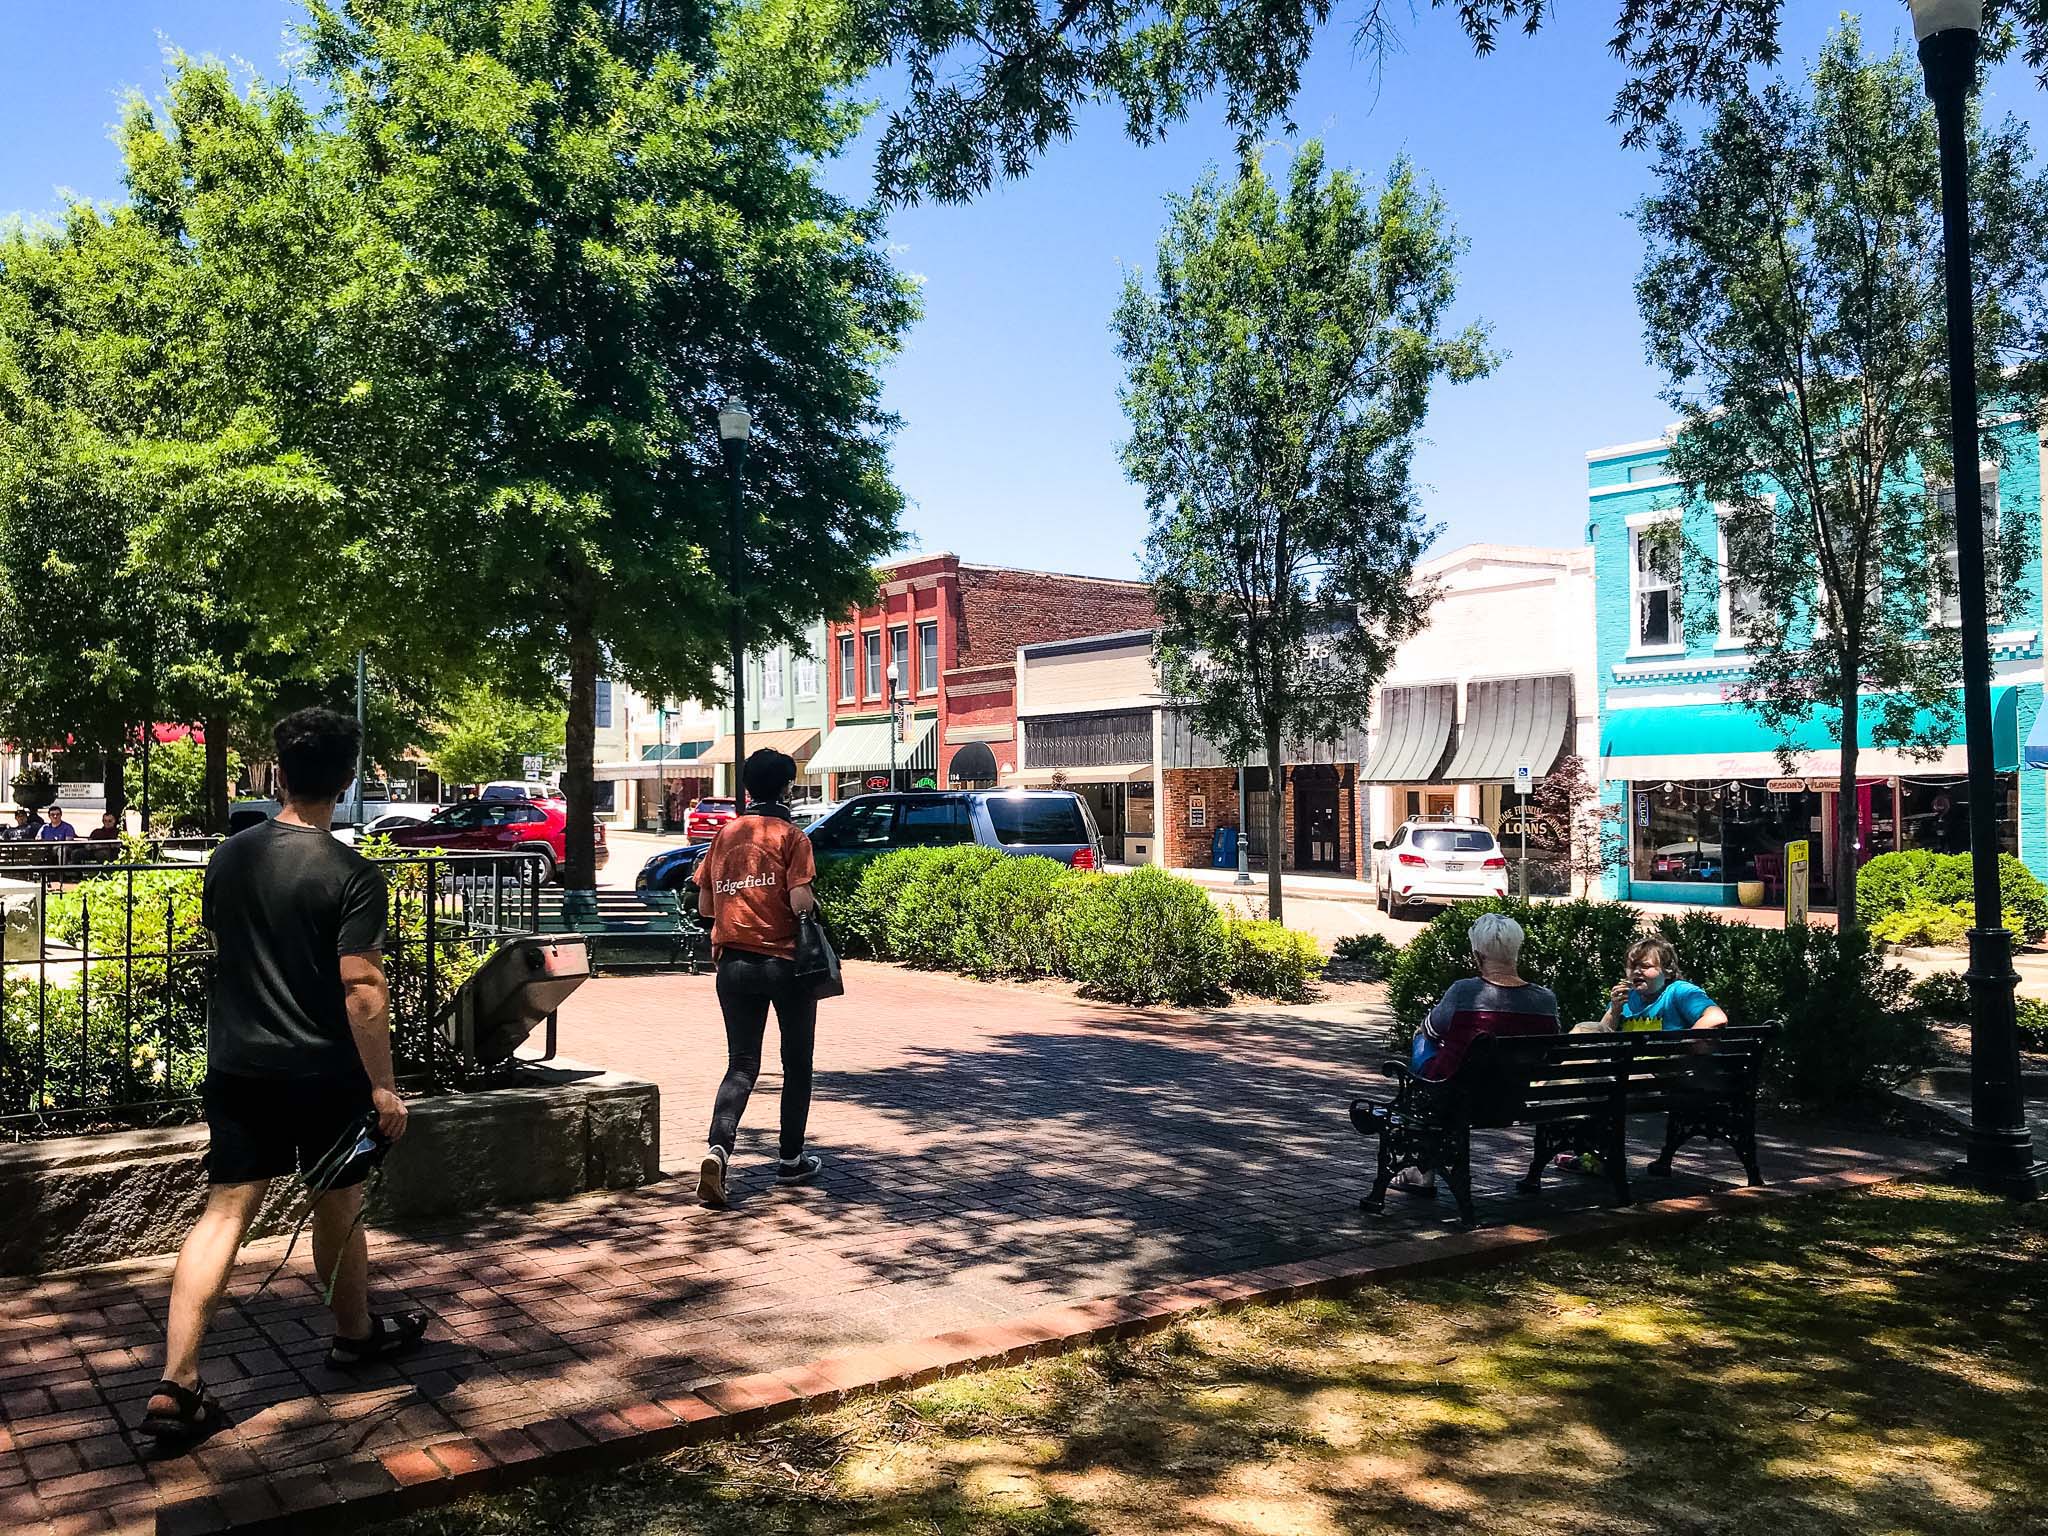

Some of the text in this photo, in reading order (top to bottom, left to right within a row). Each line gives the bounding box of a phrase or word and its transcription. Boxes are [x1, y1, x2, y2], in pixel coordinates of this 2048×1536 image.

[525, 760, 541, 770] 203
[867, 777, 889, 788] OPEN
[1639, 795, 1647, 825] OPEN
[1505, 822, 1548, 835] LOANS
[715, 871, 777, 896] Edgefield
